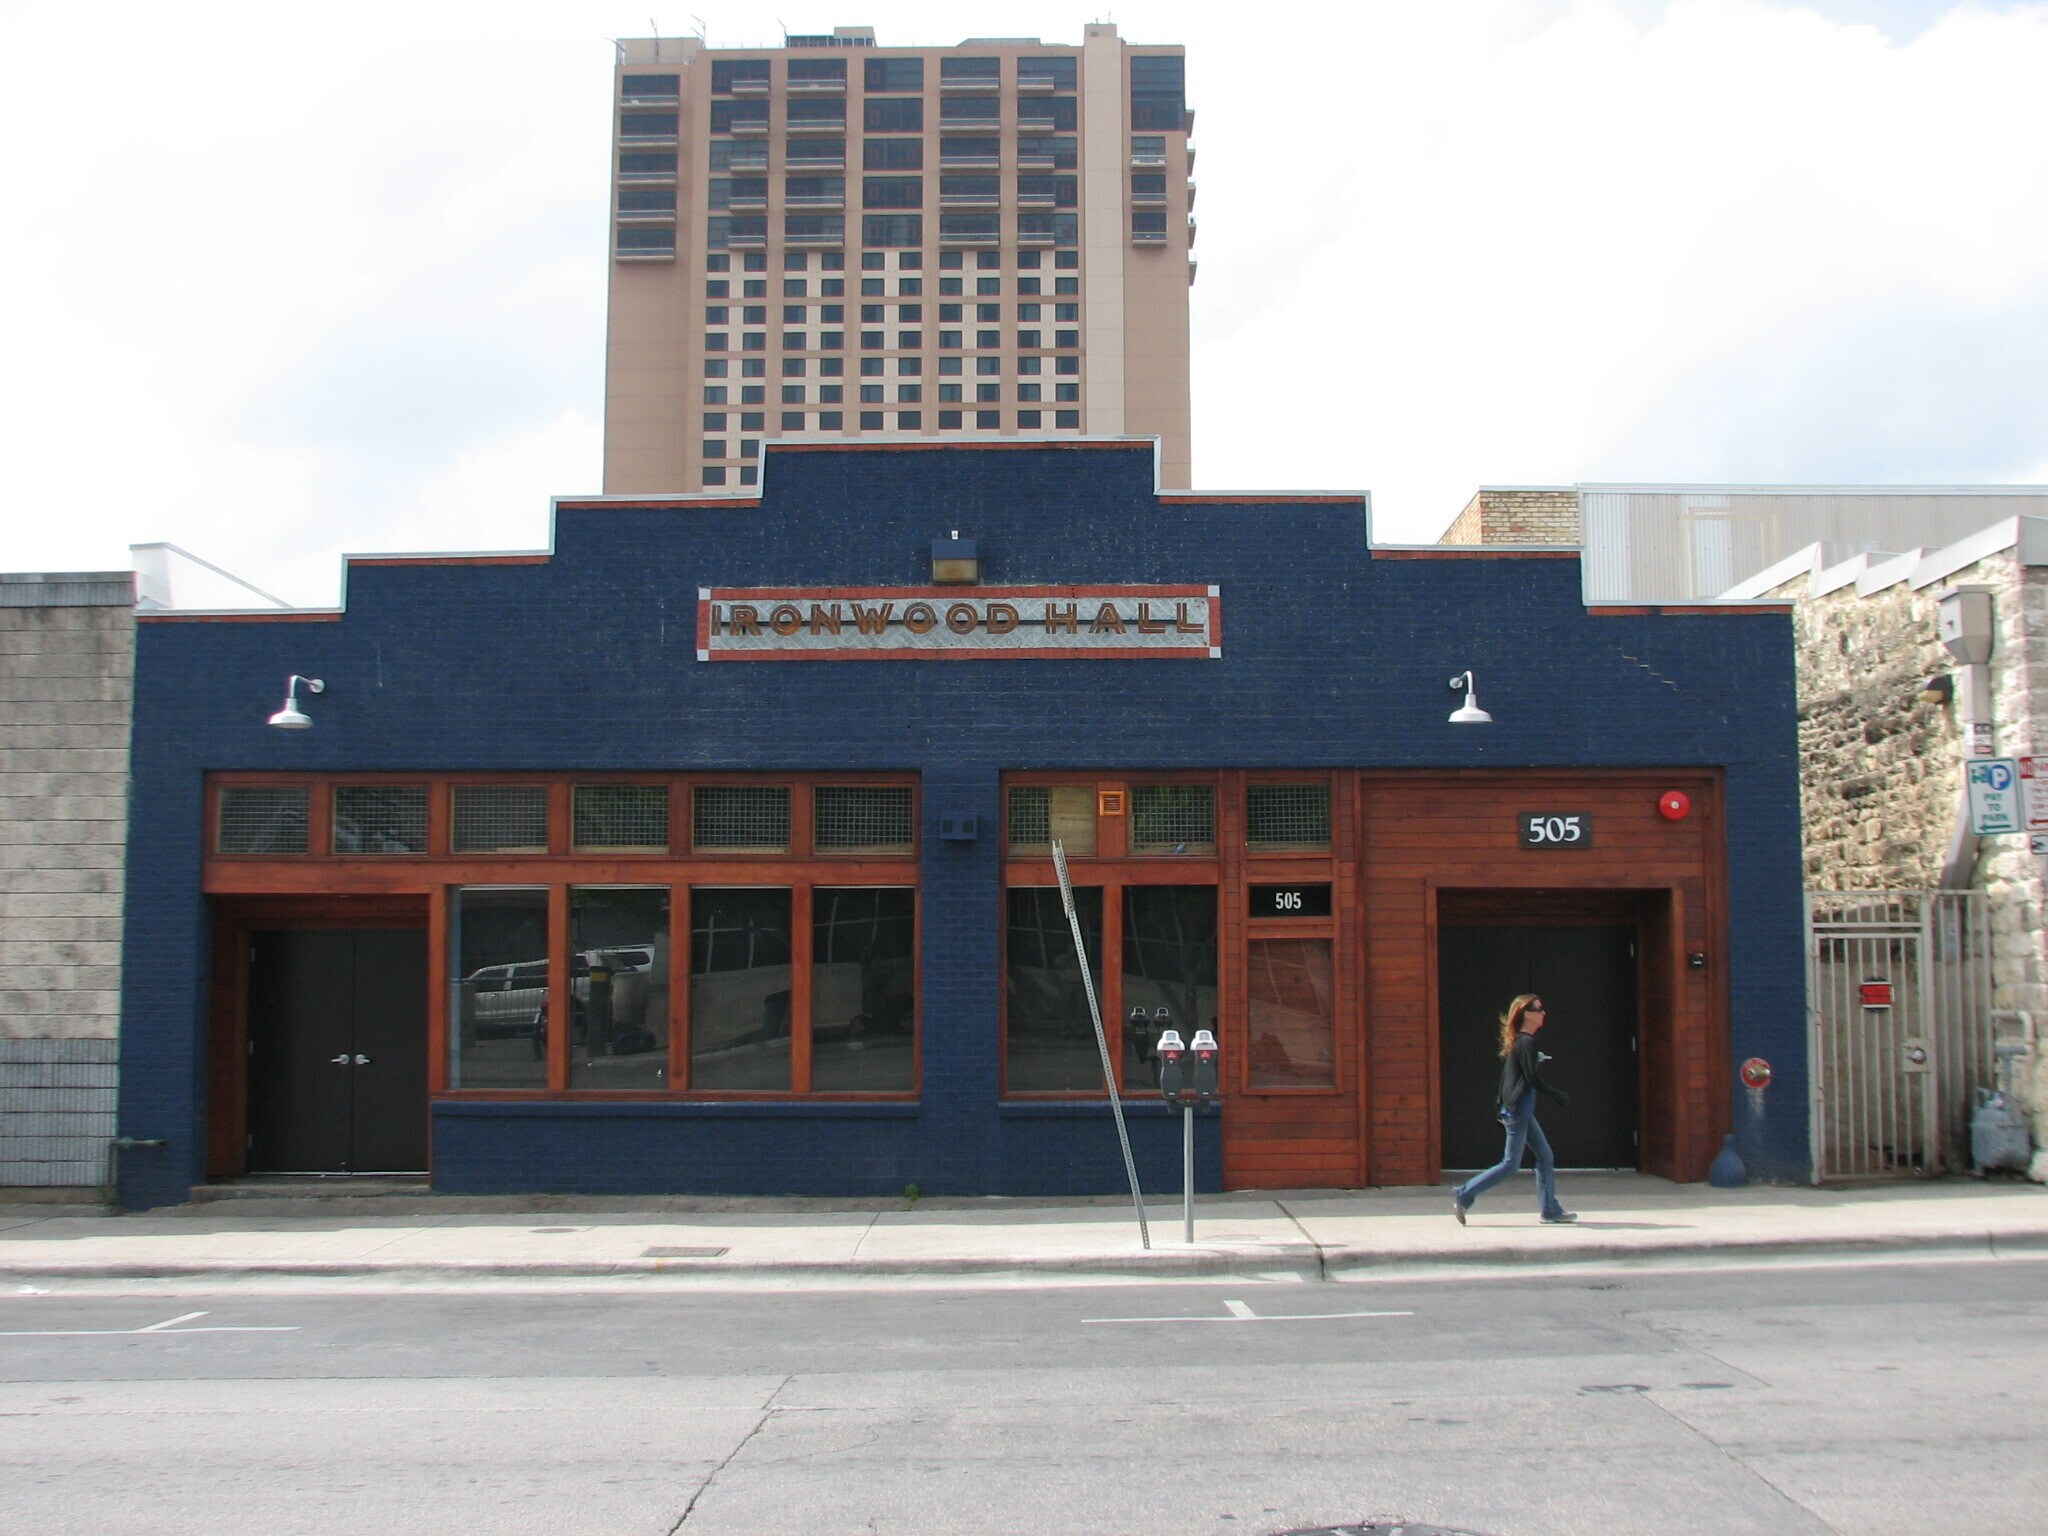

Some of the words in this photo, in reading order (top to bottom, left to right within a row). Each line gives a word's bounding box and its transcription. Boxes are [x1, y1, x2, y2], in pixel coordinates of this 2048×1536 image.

[711, 602, 1020, 636] IRONWOOD
[1045, 602, 1205, 634] HALL
[1991, 767, 2009, 789] P
[1984, 793, 2002, 801] PAY
[1987, 803, 2001, 812] TO
[1983, 813, 2009, 822] PARK
[1528, 816, 1581, 843] 505
[1275, 892, 1302, 910] 505
